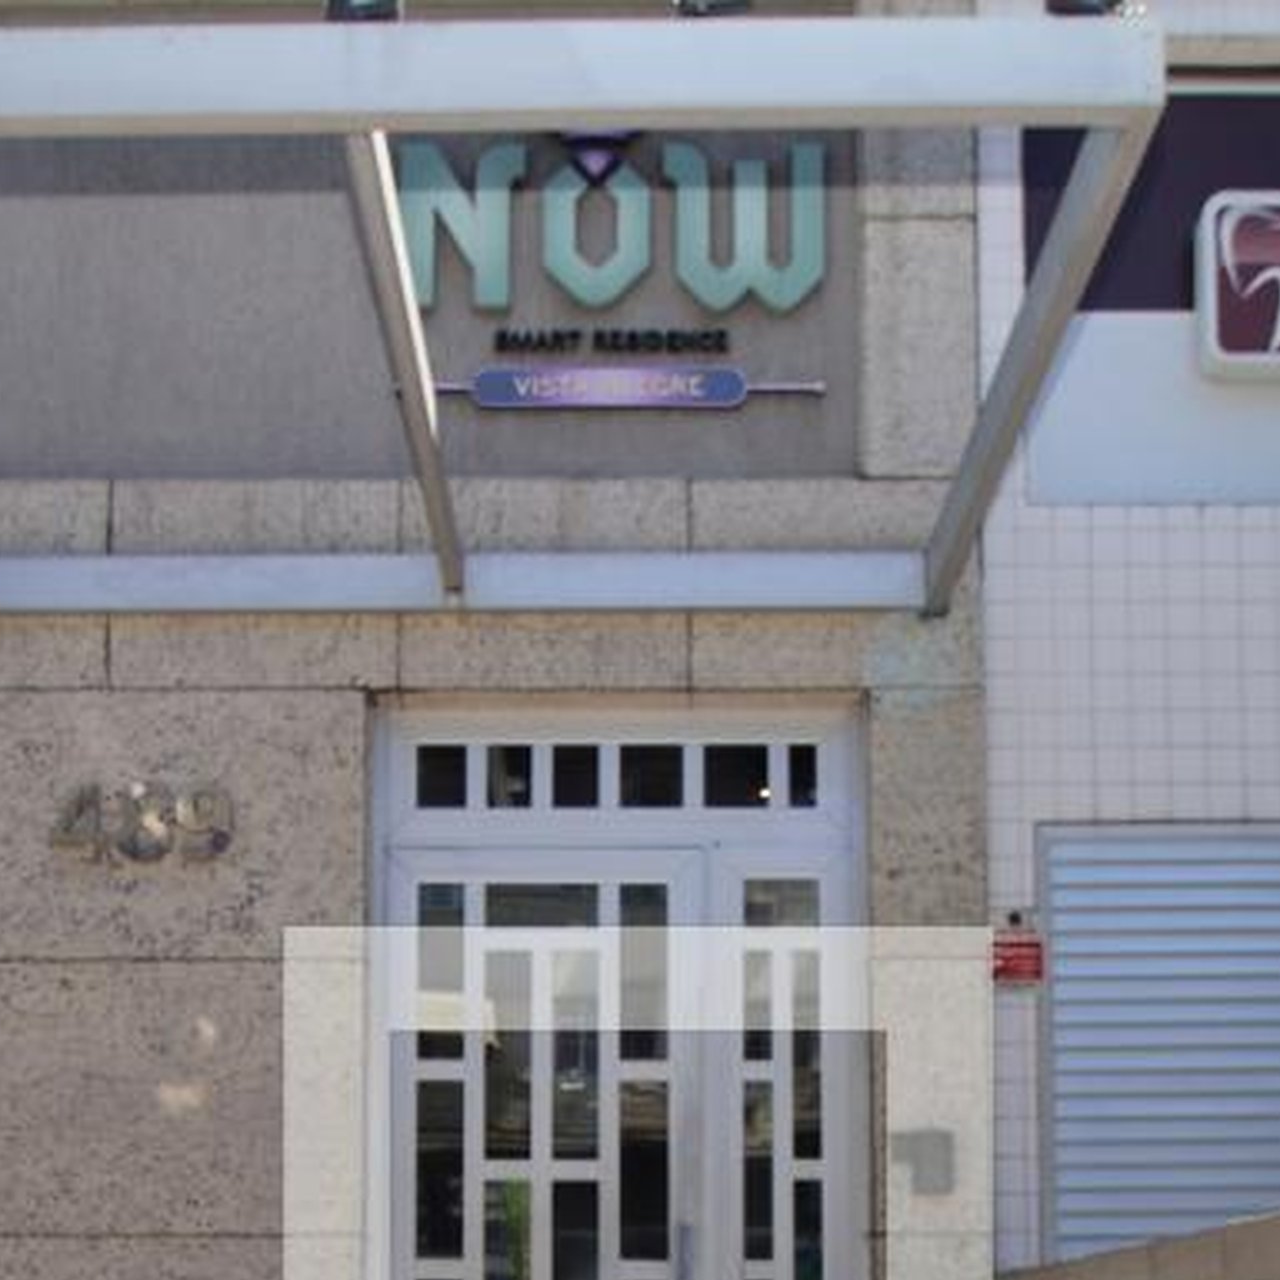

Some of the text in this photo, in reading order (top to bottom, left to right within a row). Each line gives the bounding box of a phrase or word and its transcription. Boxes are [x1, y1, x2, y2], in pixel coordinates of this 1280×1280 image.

[397, 140, 827, 313] NOW
[494, 330, 730, 353] SMART RESIDENCE
